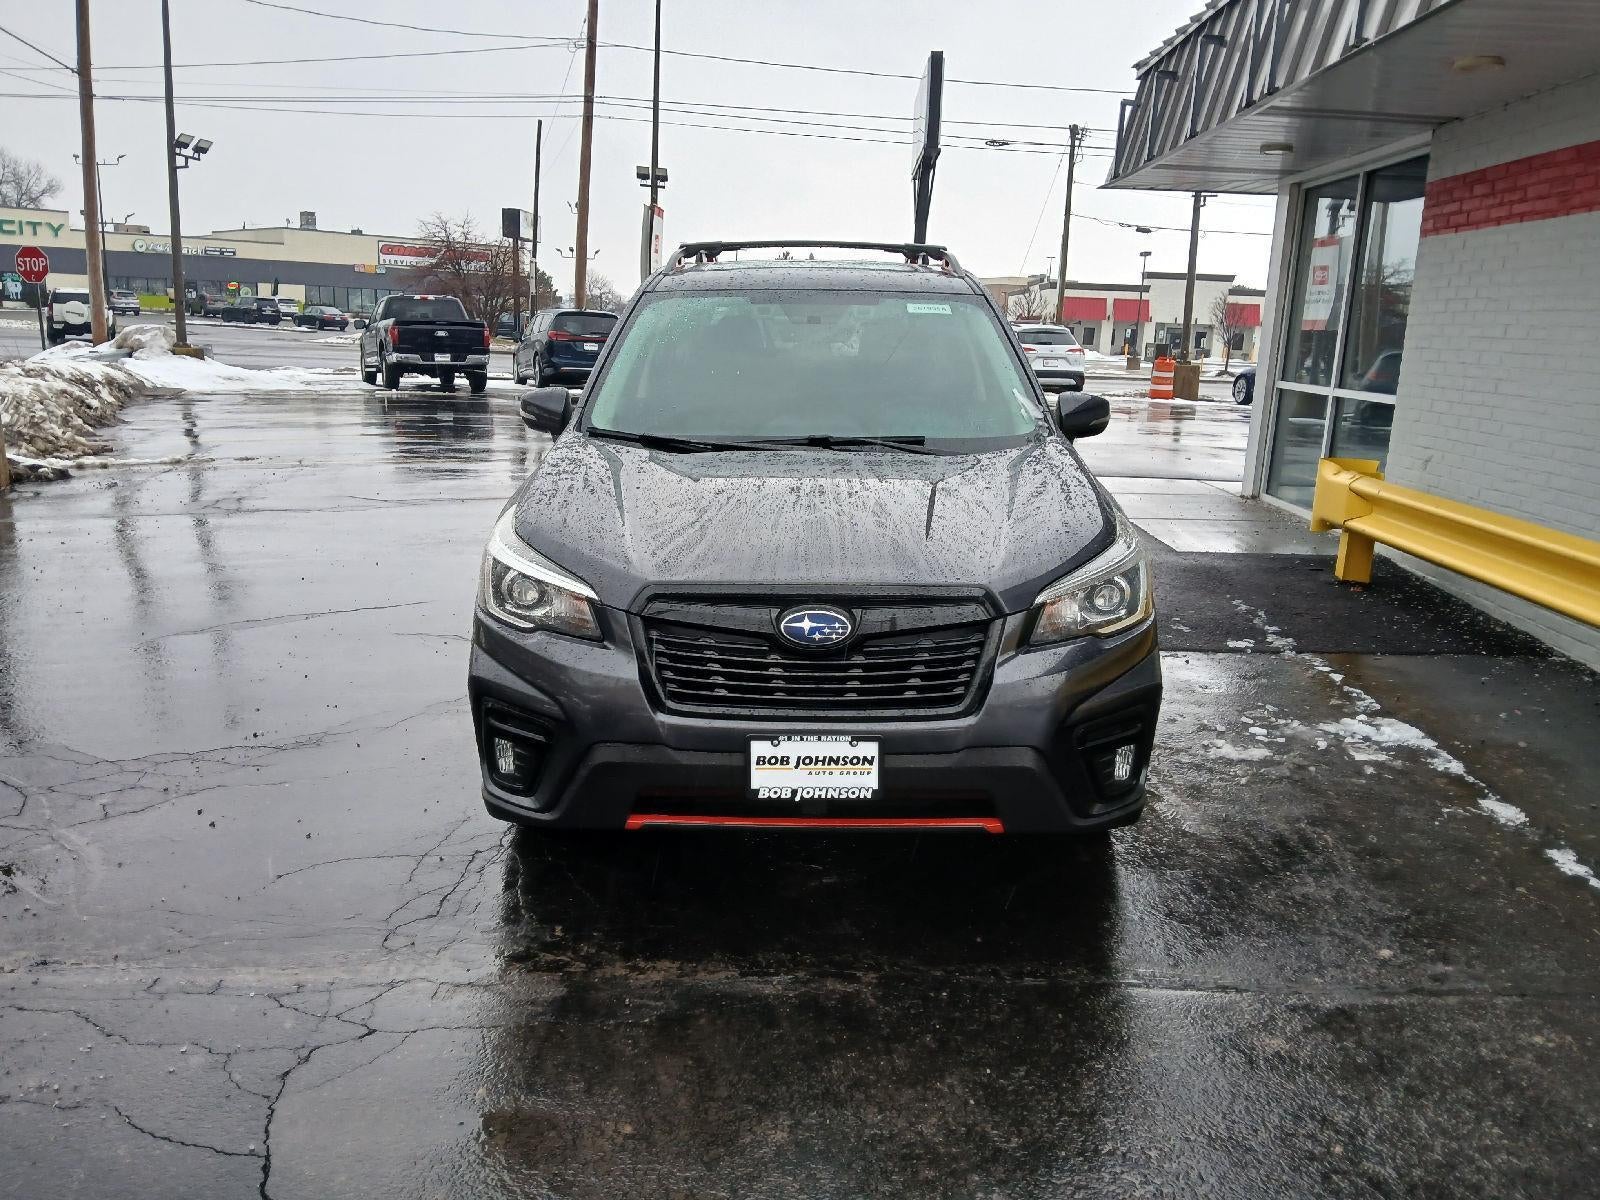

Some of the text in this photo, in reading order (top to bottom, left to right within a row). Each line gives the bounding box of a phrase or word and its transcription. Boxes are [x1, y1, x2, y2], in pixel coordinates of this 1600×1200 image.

[0, 219, 64, 237] CITY
[17, 257, 46, 272] STOP
[756, 756, 875, 769] BOB JOHNSON
[758, 787, 873, 801] BOB JOHNSON
